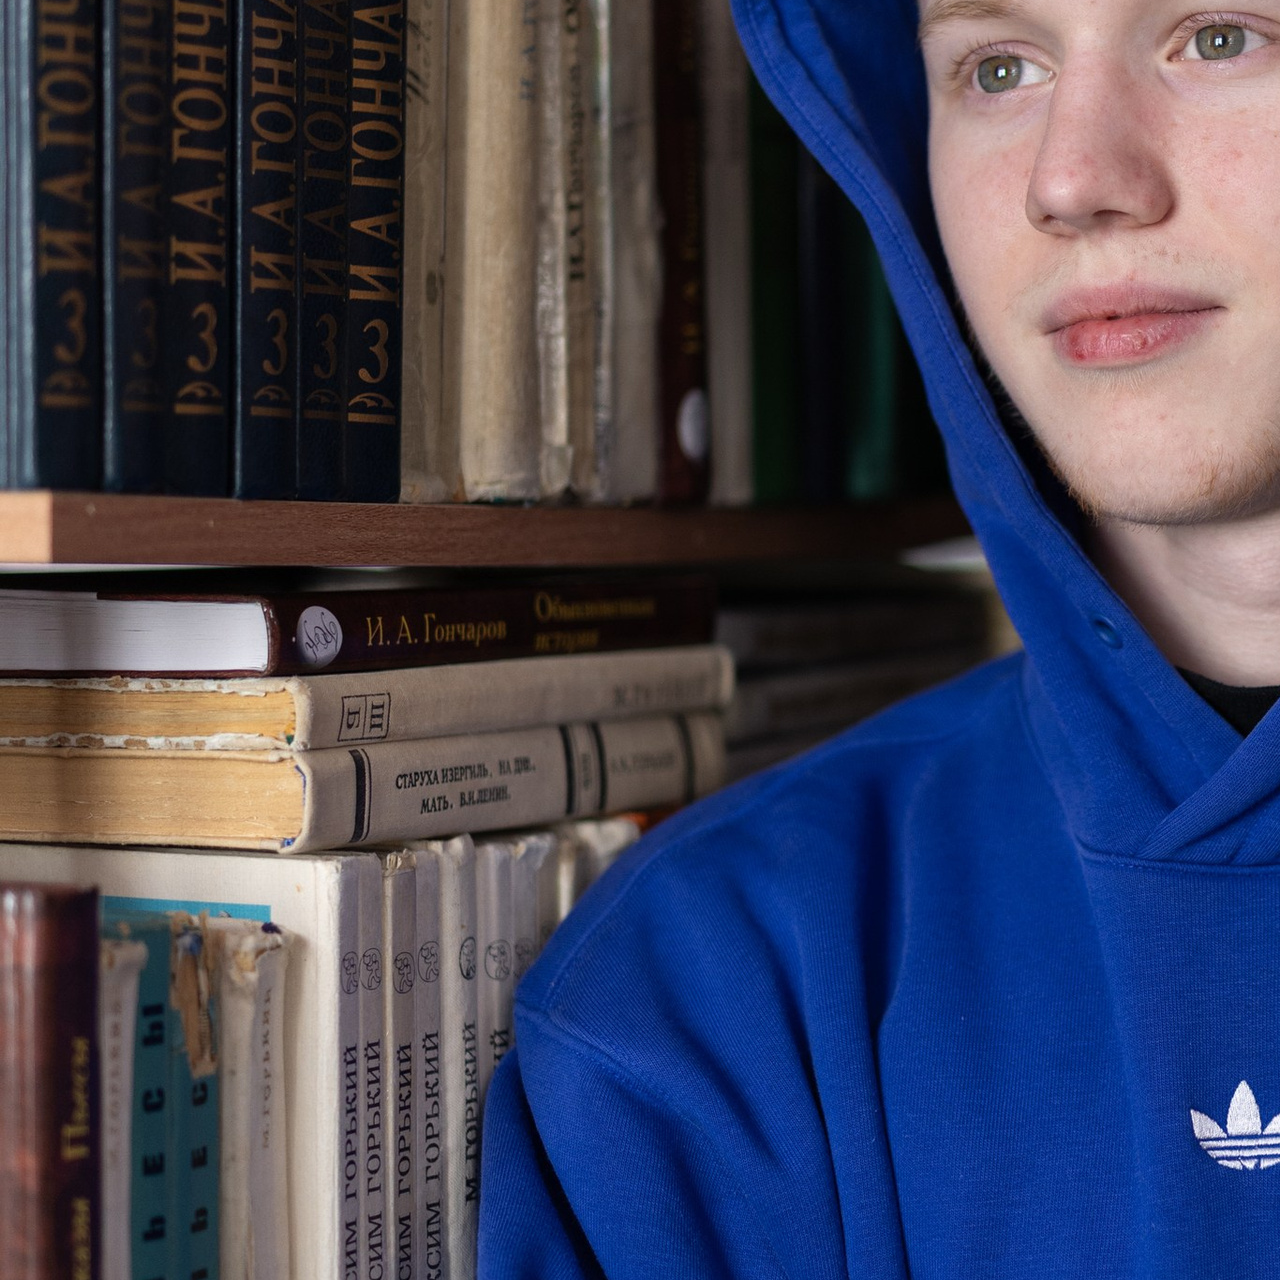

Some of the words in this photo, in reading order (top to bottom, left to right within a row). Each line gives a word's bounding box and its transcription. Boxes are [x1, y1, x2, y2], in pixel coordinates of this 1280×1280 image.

[366, 616, 391, 646] И.
[396, 615, 418, 645] А.
[423, 613, 508, 648] Гончаров
[395, 770, 439, 789] СТАРУХА
[499, 759, 512, 775] НА
[341, 1044, 359, 1202] ГОРЬКИЙ
[363, 1037, 384, 1196] ГОРЬКИЙ
[396, 1041, 413, 1198] ГОРЬКИЙ
[422, 1030, 442, 1185] ГОРЬКИЙ
